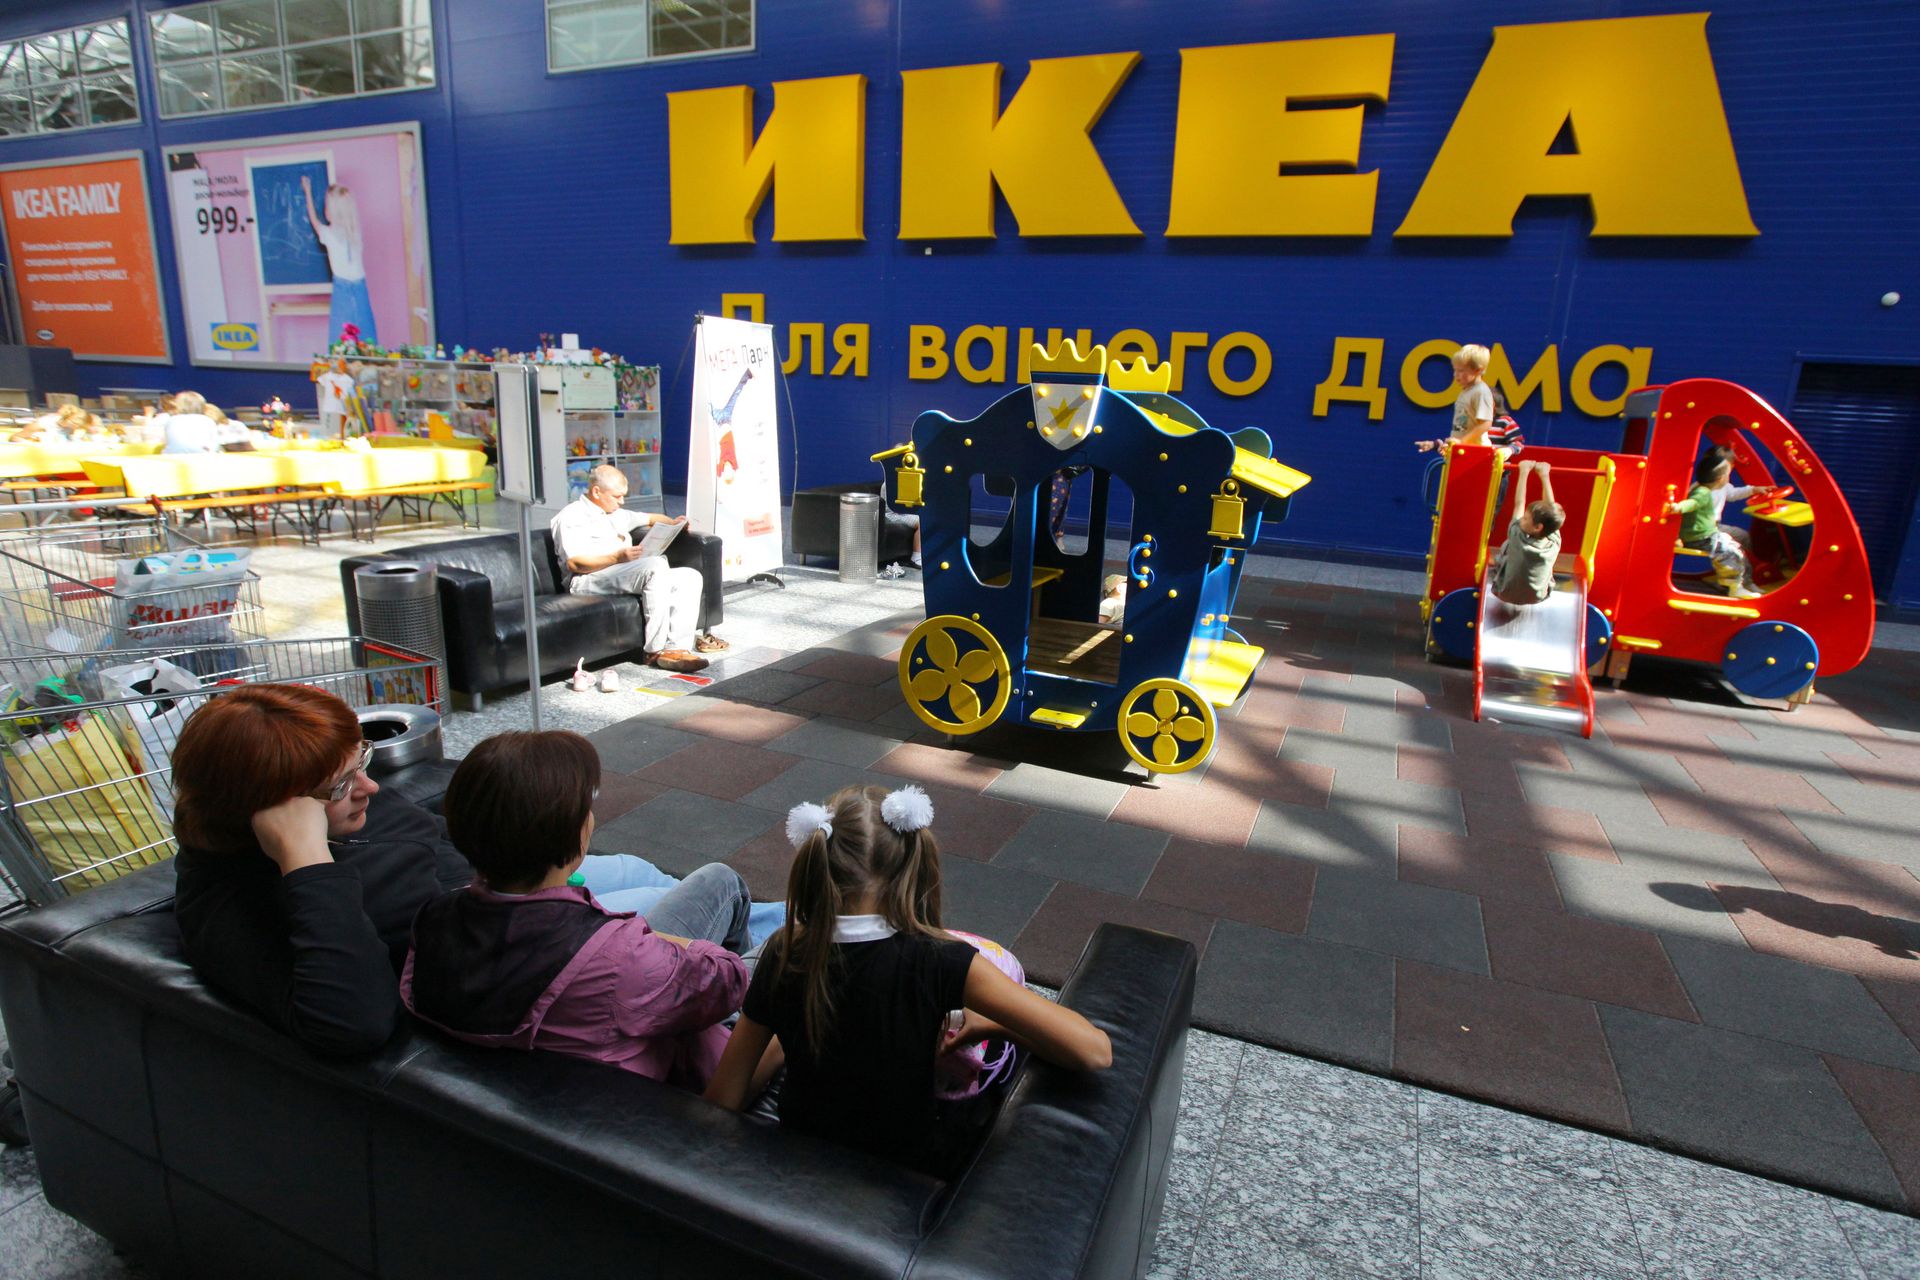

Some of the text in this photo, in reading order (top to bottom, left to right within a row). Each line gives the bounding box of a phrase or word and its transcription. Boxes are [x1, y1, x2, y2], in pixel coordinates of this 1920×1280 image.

[667, 11, 1762, 246] ИКЕА
[12, 182, 121, 218] IKEA FAMILY
[218, 331, 253, 342] IKEA
[1312, 336, 1653, 420] дома
